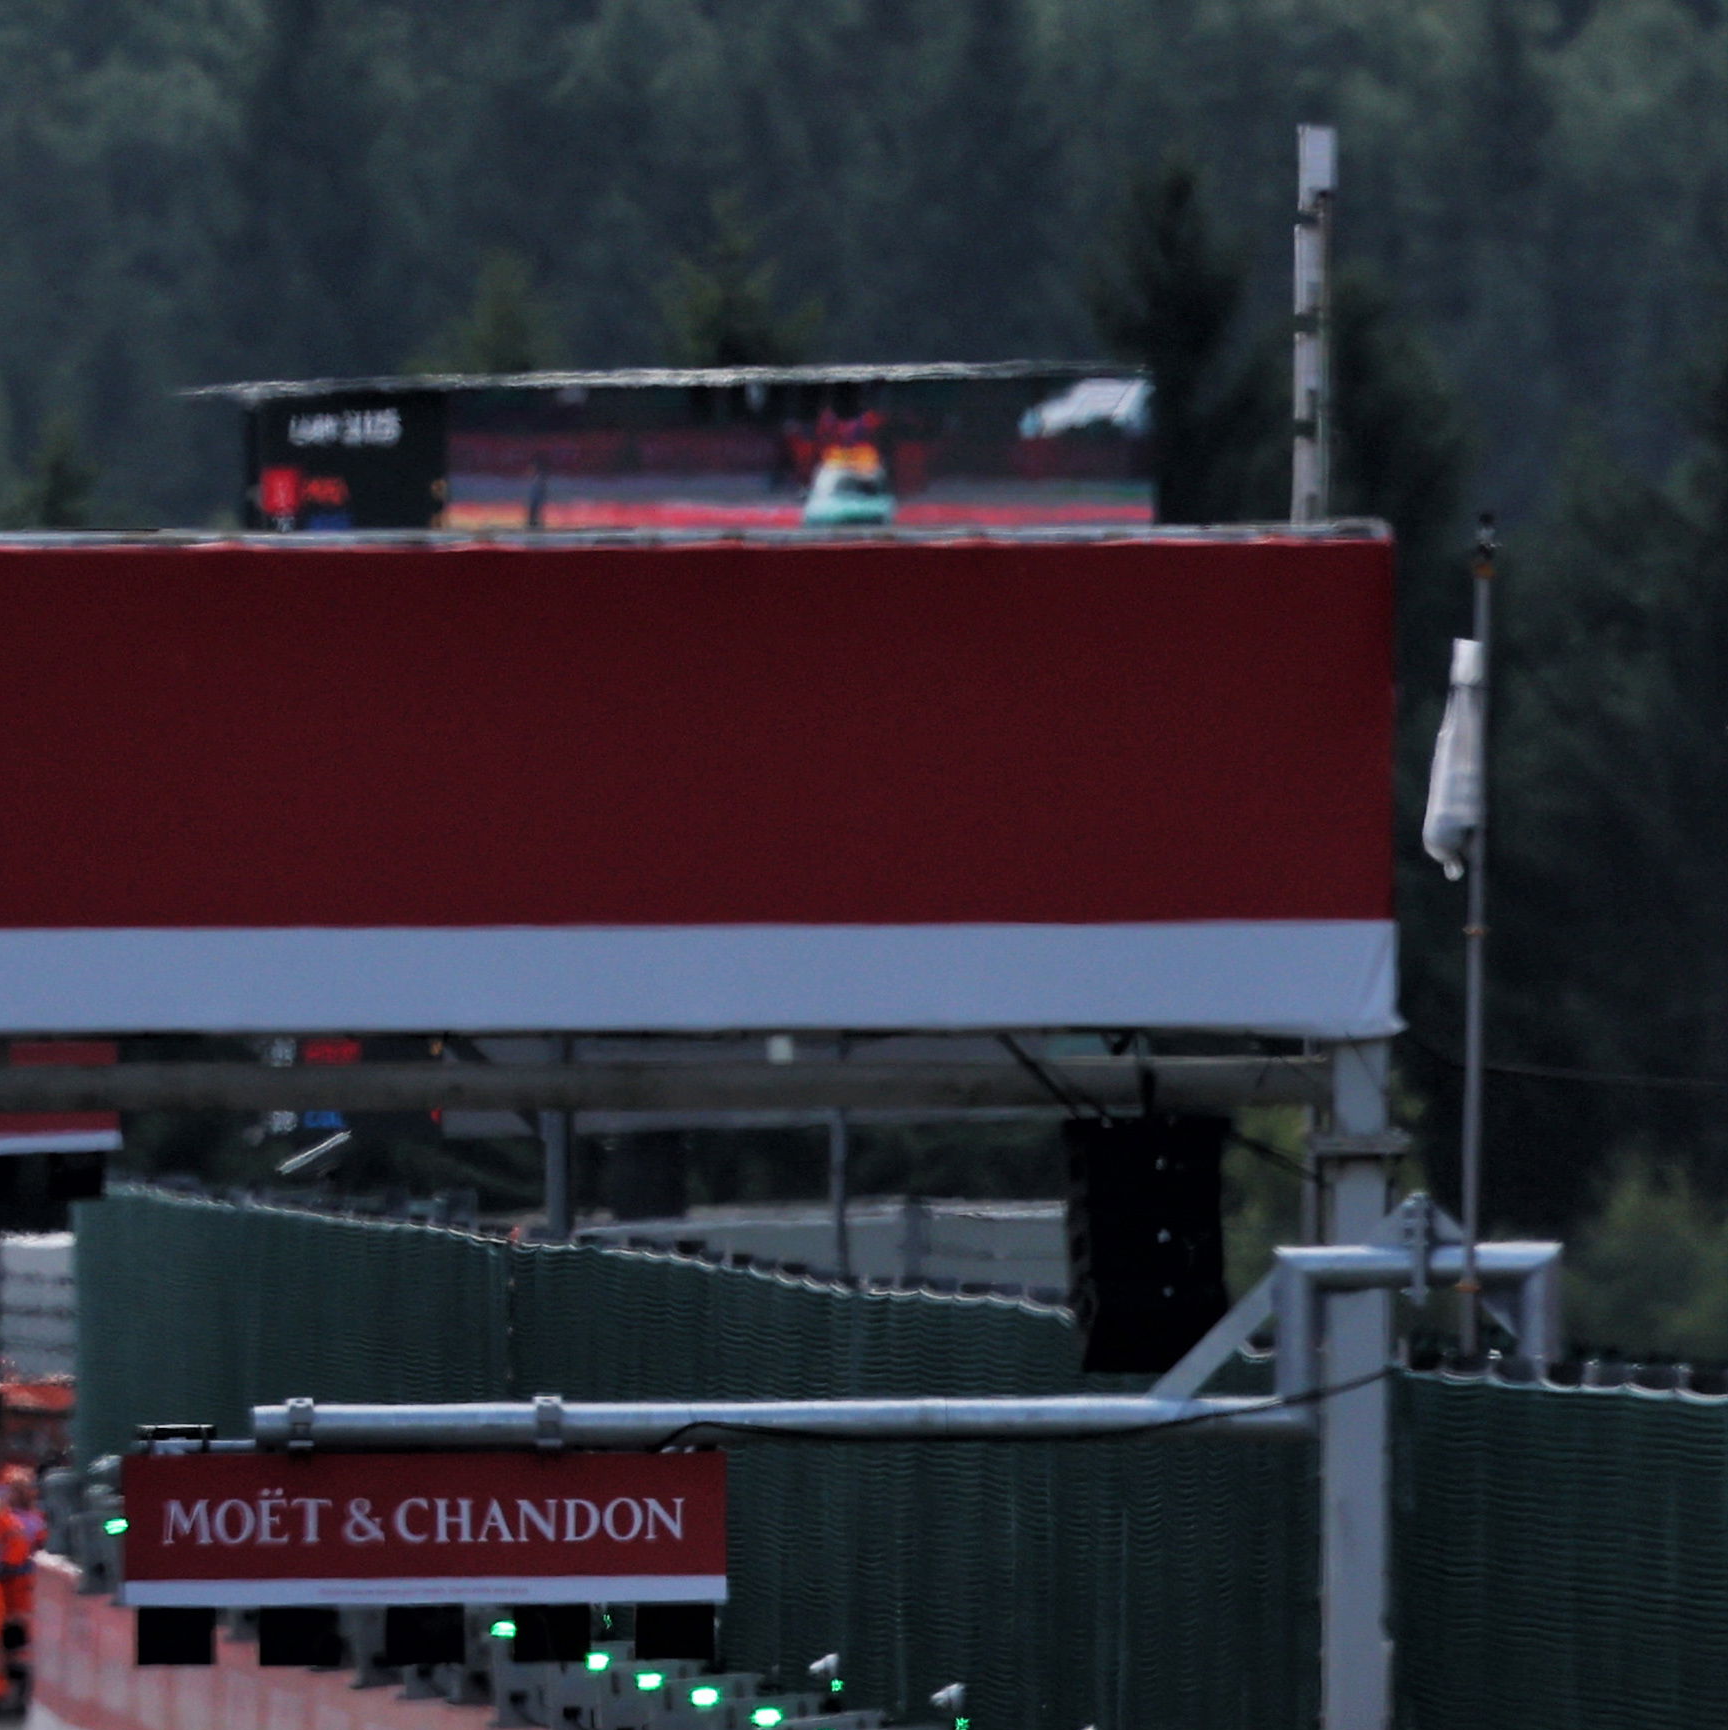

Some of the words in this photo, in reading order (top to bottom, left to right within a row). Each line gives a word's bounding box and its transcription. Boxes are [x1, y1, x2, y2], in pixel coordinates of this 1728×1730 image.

[161, 1488, 334, 1545] MOËT
[342, 1498, 386, 1544] &
[392, 1496, 687, 1544] CHANDON
